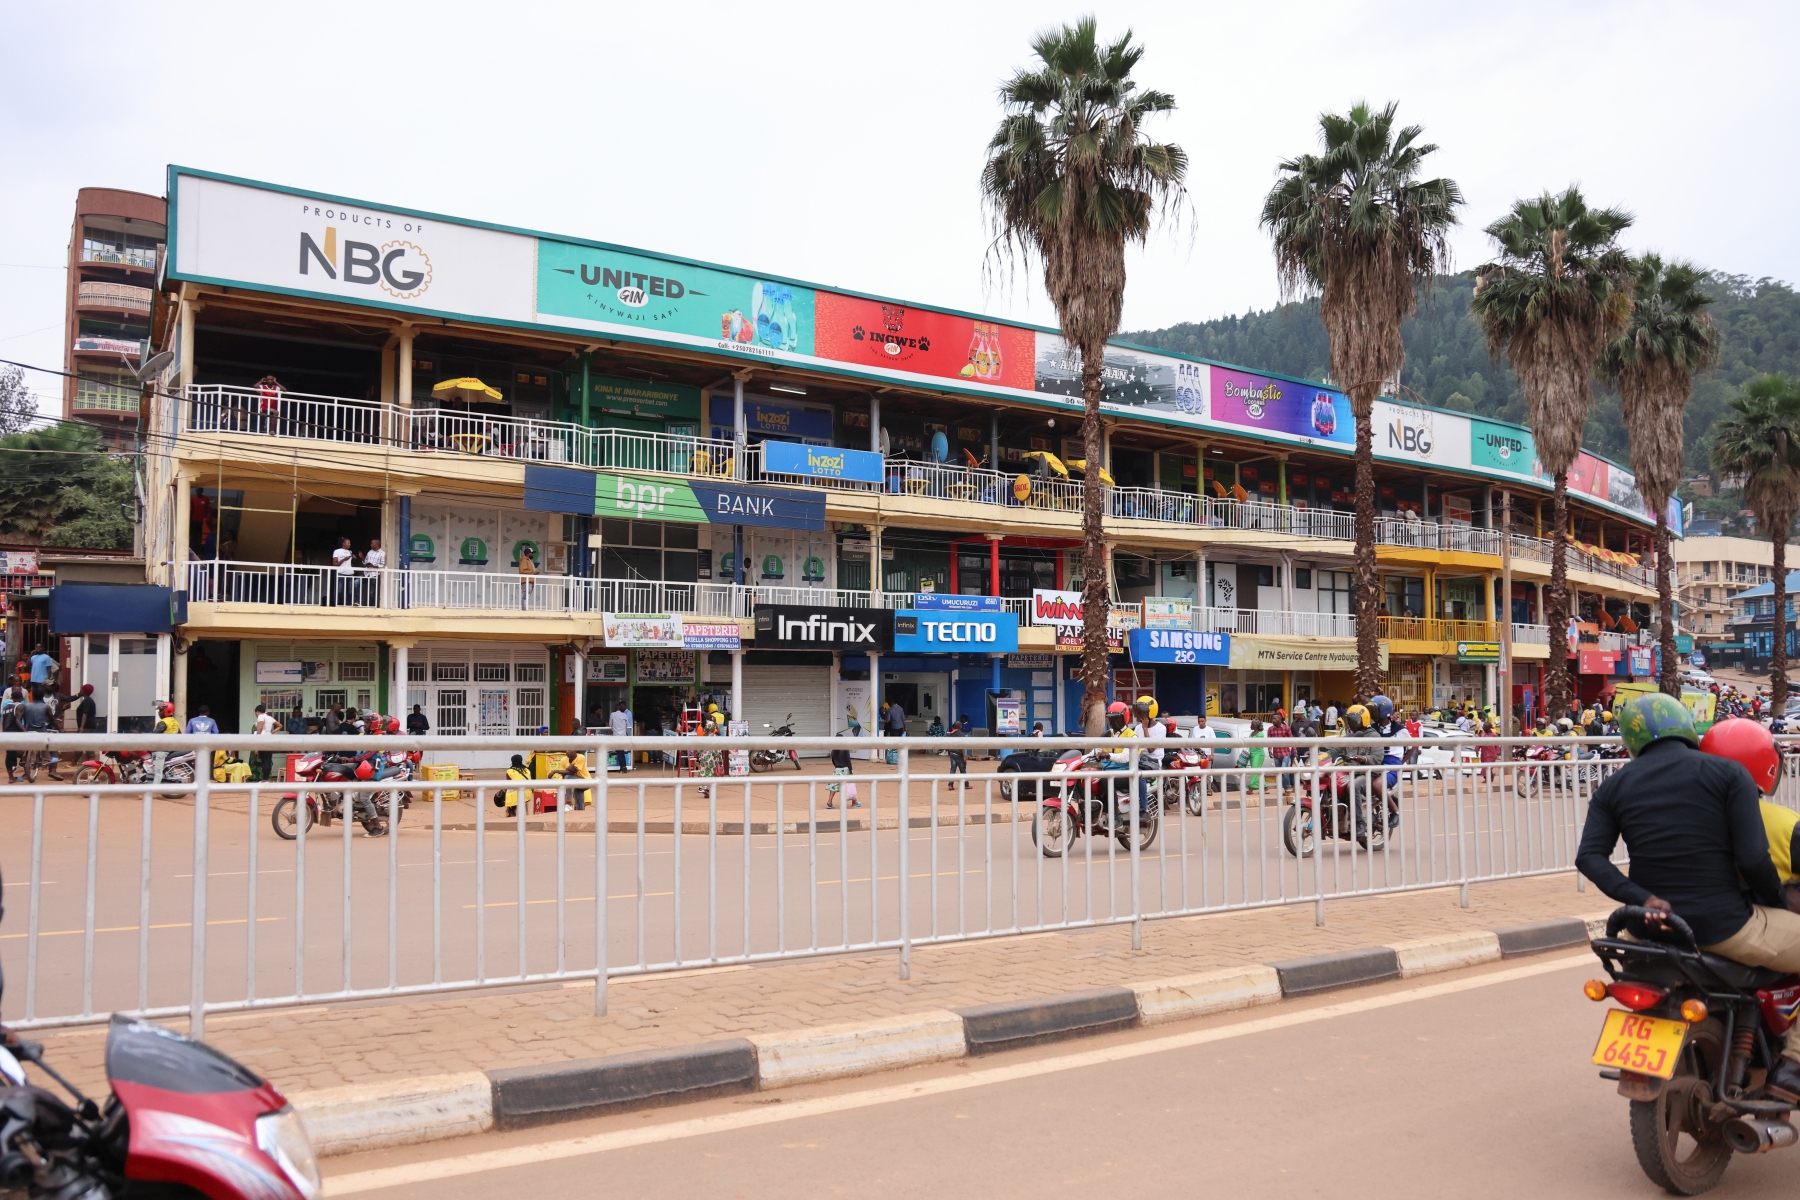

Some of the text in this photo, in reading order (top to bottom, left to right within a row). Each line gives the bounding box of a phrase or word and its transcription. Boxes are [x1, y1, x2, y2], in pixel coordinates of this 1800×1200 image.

[303, 205, 423, 234] PRODUCTS OF
[299, 226, 425, 291] NBG
[580, 263, 685, 299] UNITED
[619, 289, 645, 304] GIN
[586, 293, 679, 321] KINYWAJI SAFI
[869, 331, 917, 348] INGWE
[594, 384, 613, 393] KINA
[1224, 380, 1283, 401] Bombastic
[760, 422, 788, 432] LOTTO
[1388, 418, 1432, 454] NBG
[1485, 433, 1522, 453] UNITED
[812, 466, 842, 476] LOTTO
[616, 474, 775, 518] bpr BANK
[682, 624, 739, 637] PAPETERIE
[778, 614, 876, 643] Infinix
[921, 621, 997, 642] TECNO
[1057, 625, 1123, 640] PAPRIE
[1061, 637, 1078, 645] JOEL
[1149, 630, 1222, 652] SAMSUNG
[639, 651, 694, 660] PAPETERIE
[1174, 650, 1196, 663] 250
[1257, 650, 1275, 660] MTN
[1276, 650, 1303, 660] Service
[1304, 651, 1328, 661] Centre
[1619, 1015, 1656, 1041] RG
[1603, 1040, 1667, 1072] 645J
